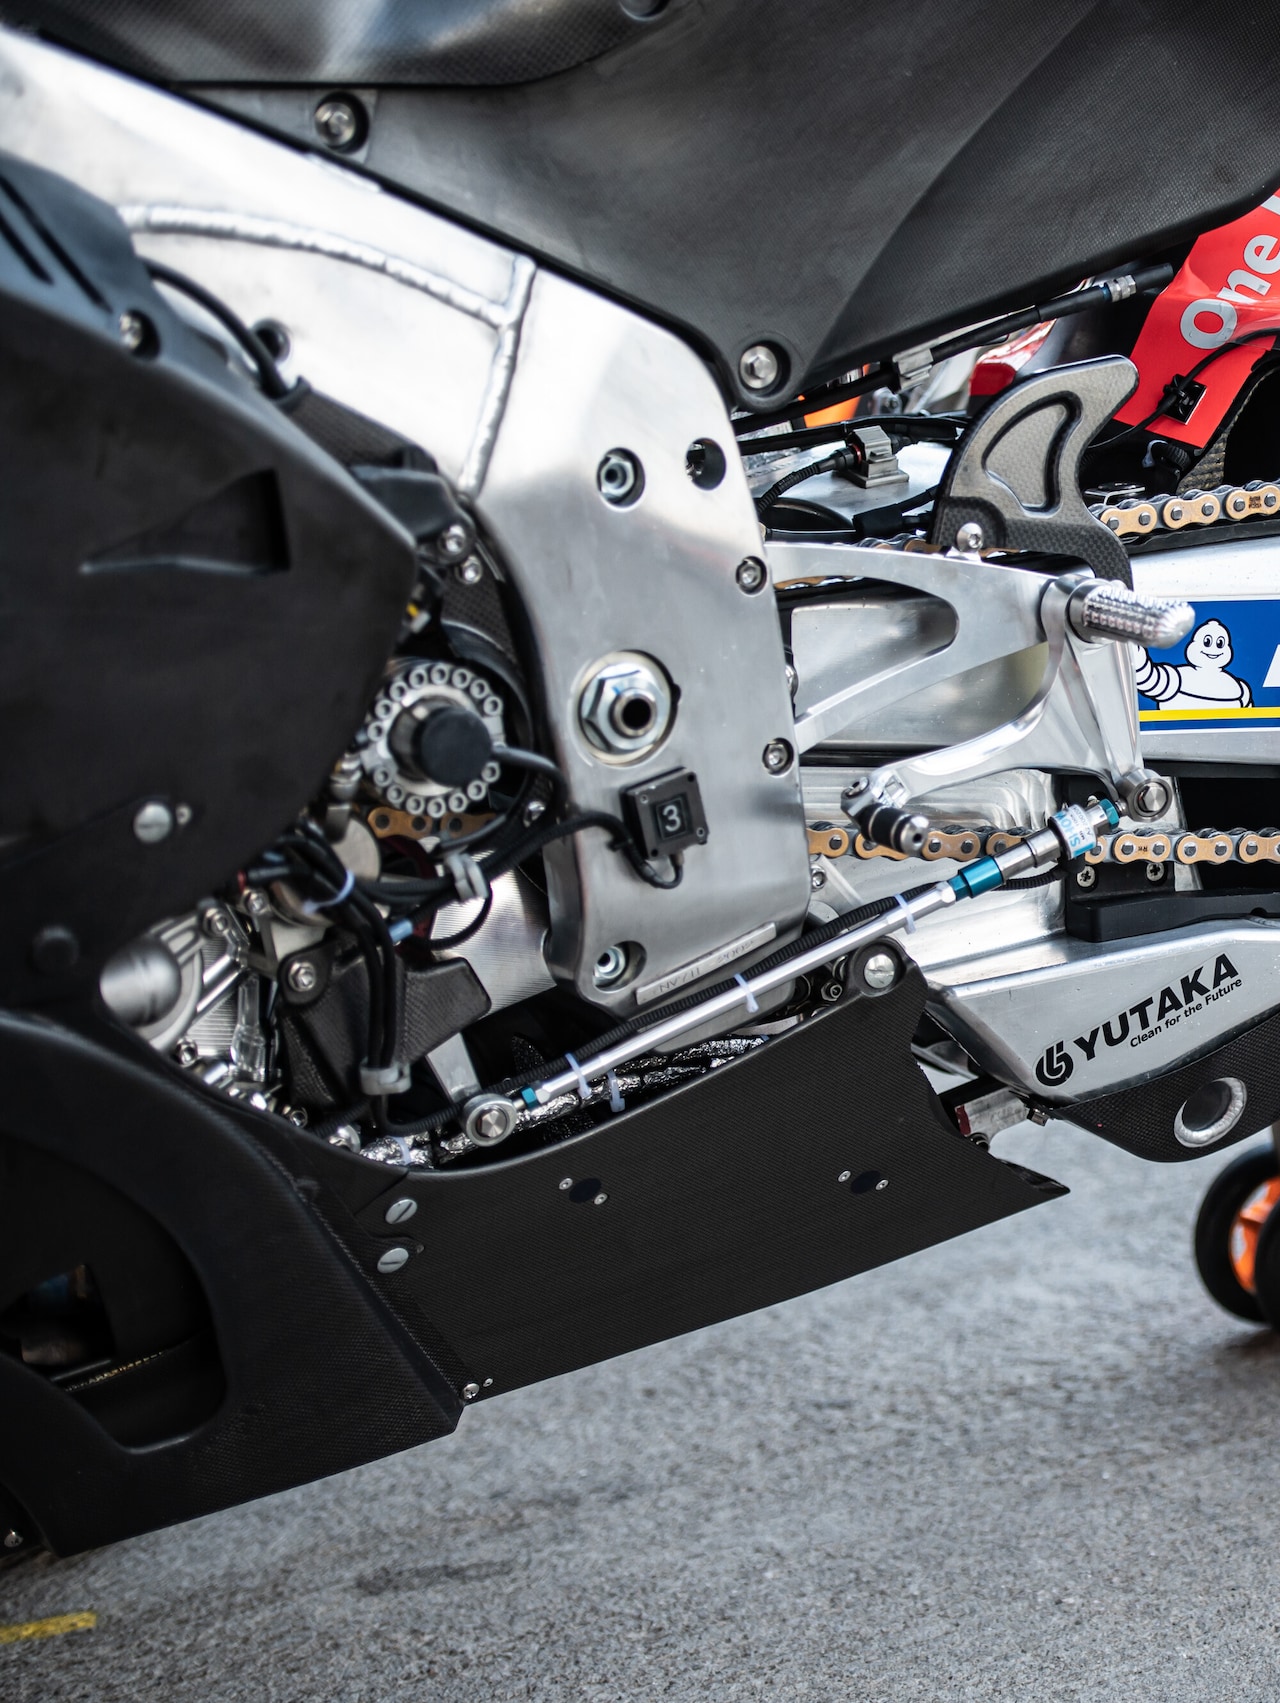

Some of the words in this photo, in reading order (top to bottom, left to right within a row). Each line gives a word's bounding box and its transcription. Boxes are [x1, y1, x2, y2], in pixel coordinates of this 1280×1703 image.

[662, 804, 681, 832] 3
[1073, 952, 1239, 1061] YUTAKA
[1130, 1026, 1163, 1048] Clean
[1164, 1014, 1182, 1029] for
[1183, 1002, 1203, 1018] the
[1204, 978, 1243, 1006] Future
